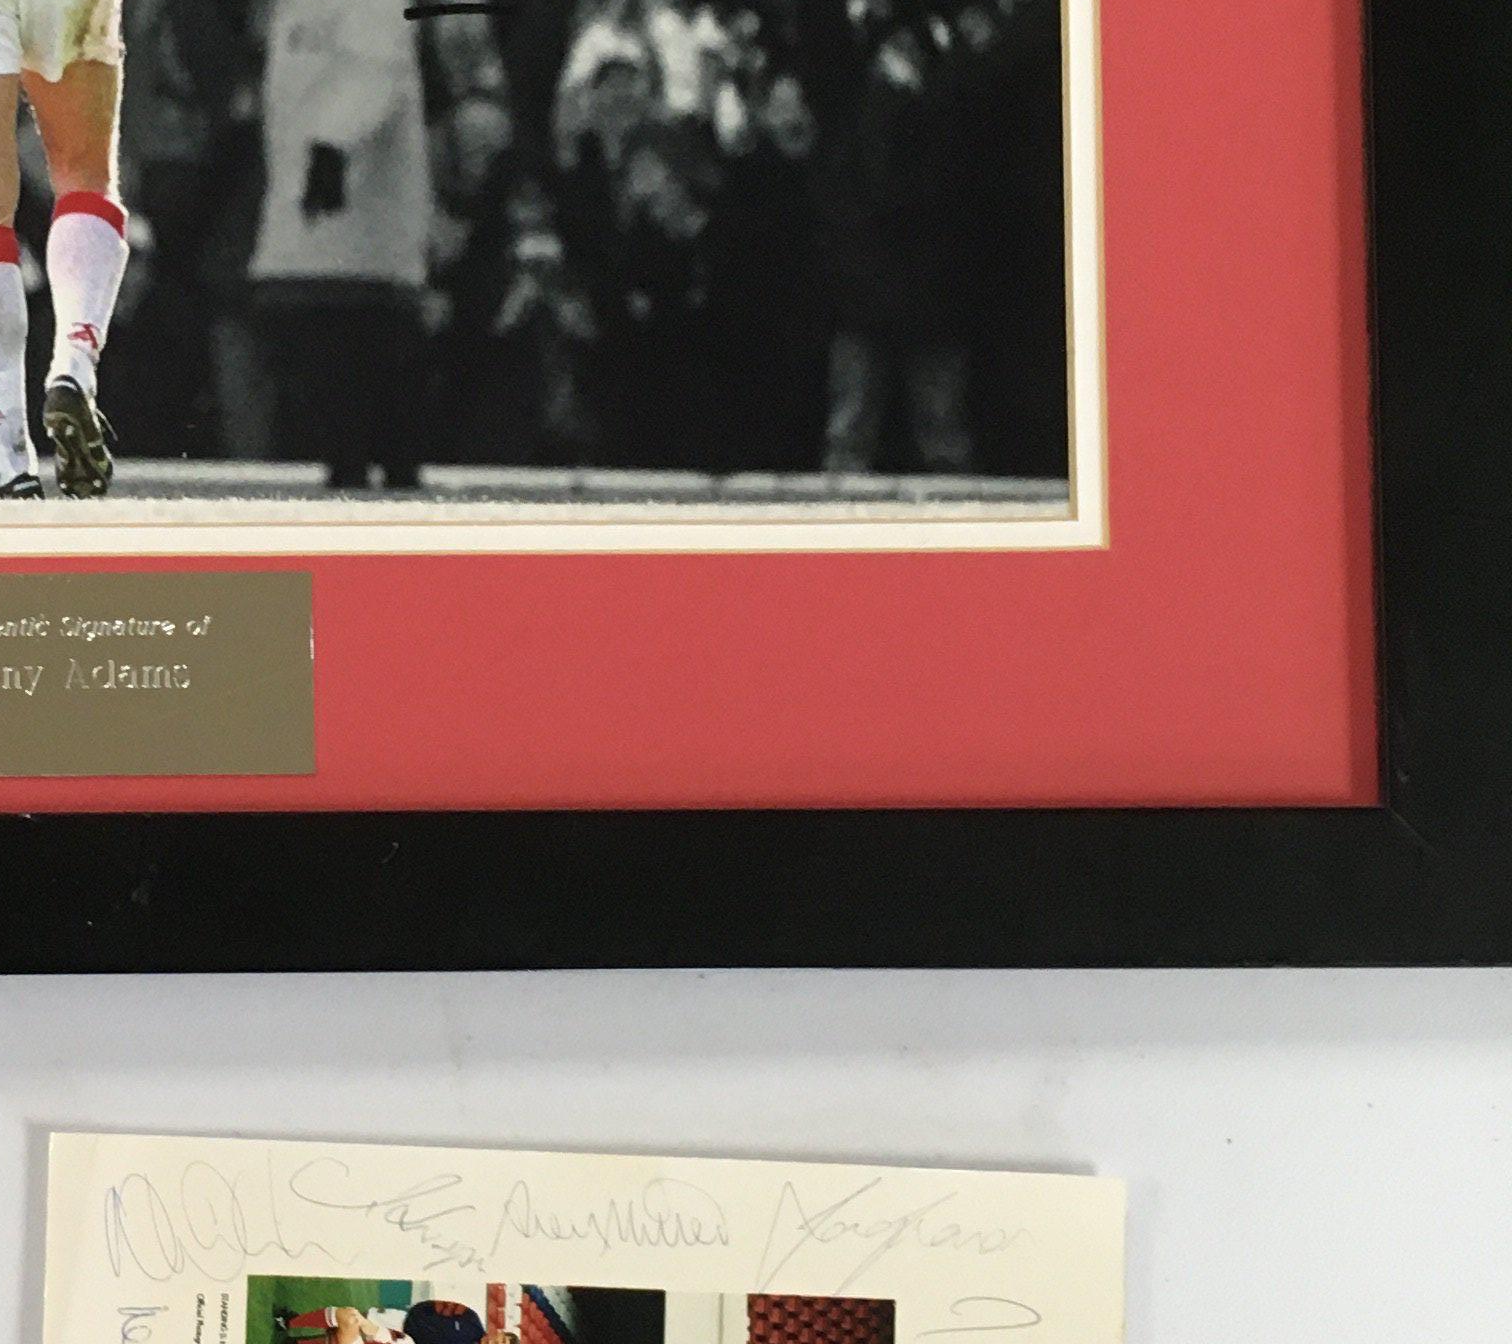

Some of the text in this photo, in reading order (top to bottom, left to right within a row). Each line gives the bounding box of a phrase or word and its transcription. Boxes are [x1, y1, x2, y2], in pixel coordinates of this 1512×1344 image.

[61, 615, 176, 641] Signature
[185, 615, 212, 638] of
[64, 658, 191, 690] Adams
